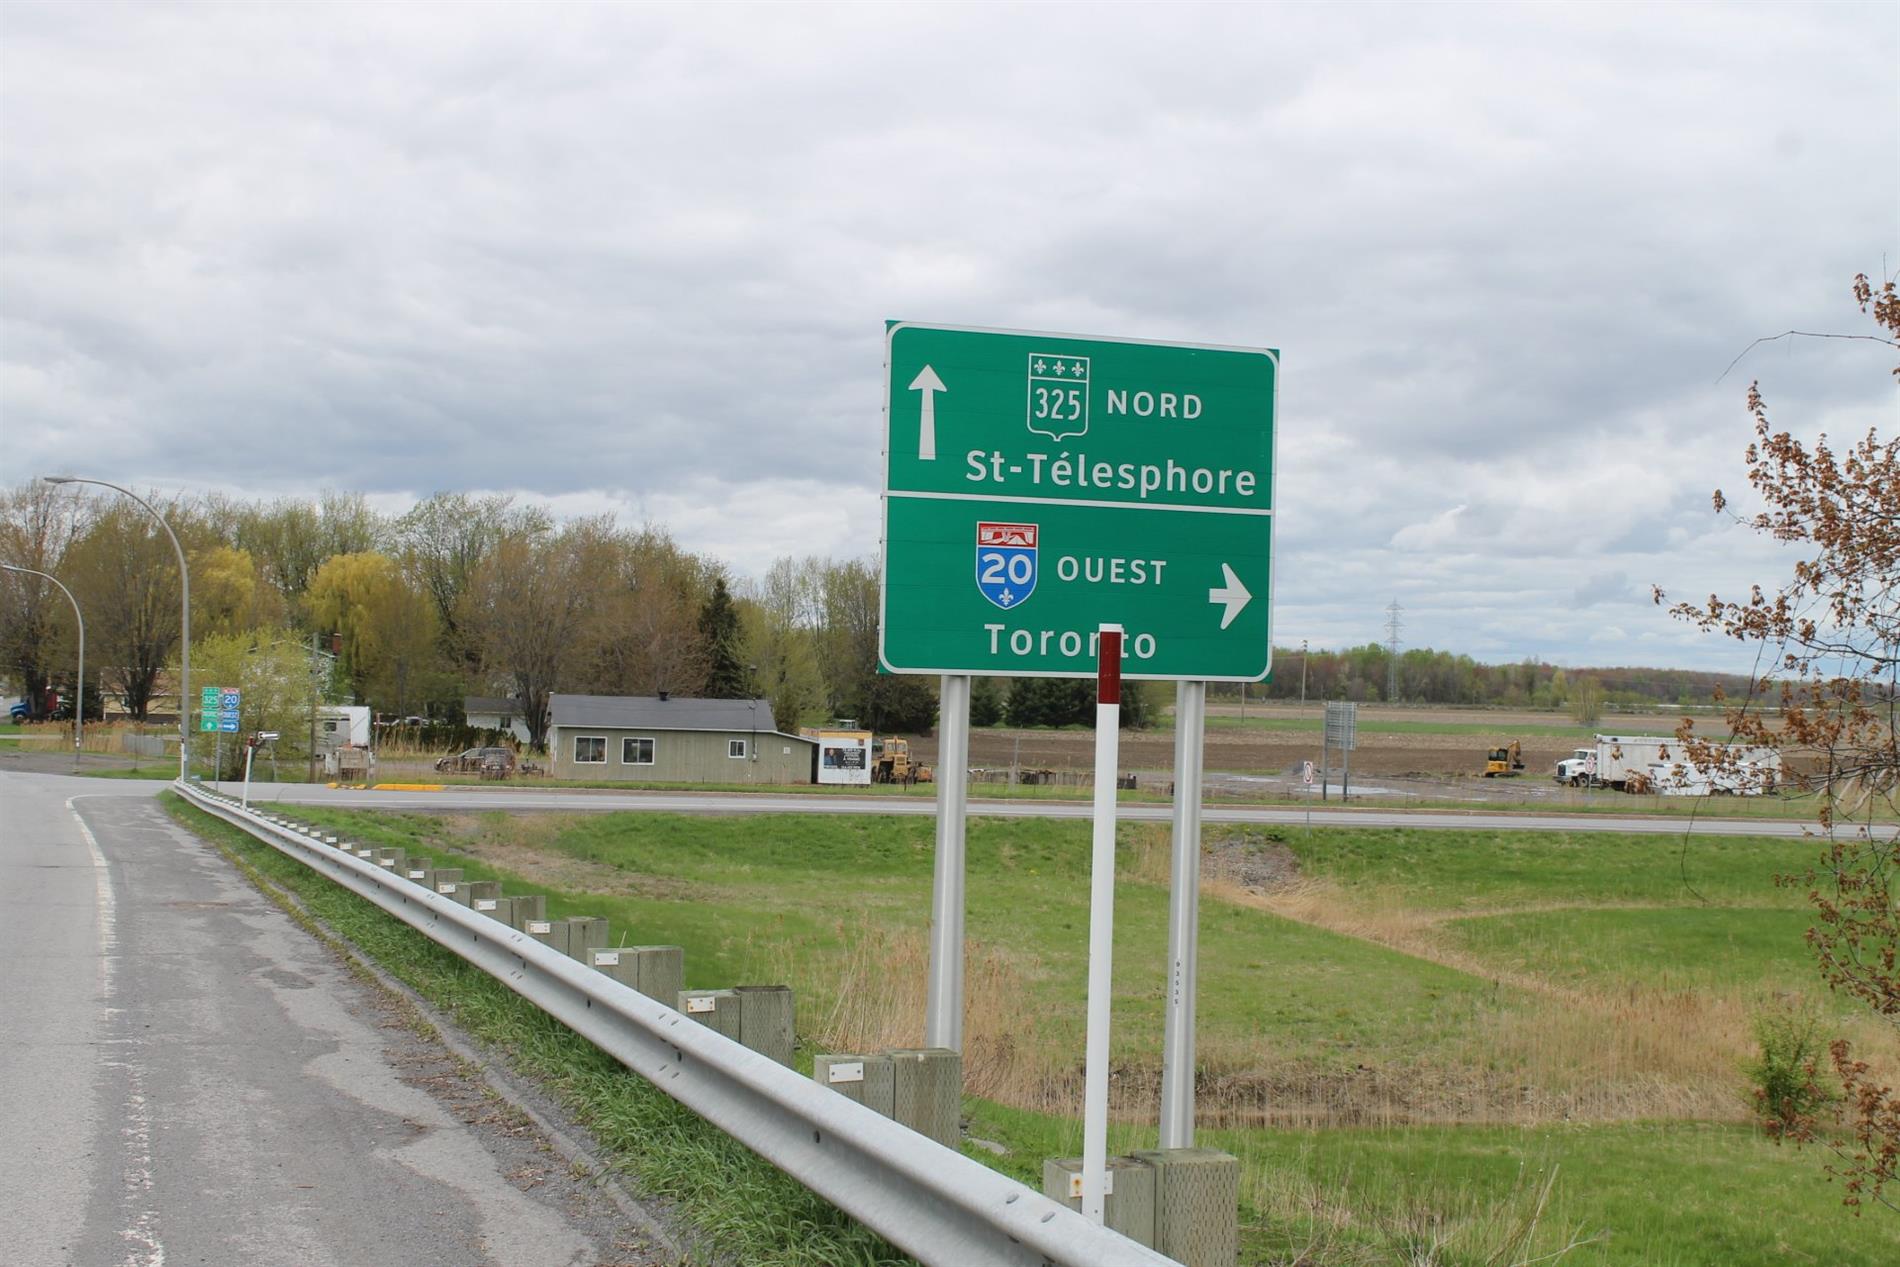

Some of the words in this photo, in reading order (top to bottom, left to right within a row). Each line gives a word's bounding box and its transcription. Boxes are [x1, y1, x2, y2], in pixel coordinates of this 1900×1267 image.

[1035, 388, 1081, 420] 325
[1107, 389, 1202, 419] NORD
[966, 450, 1256, 498] St-Télesphore
[981, 552, 1033, 585] 20
[1057, 556, 1167, 585] OUEST
[224, 695, 237, 704] 20
